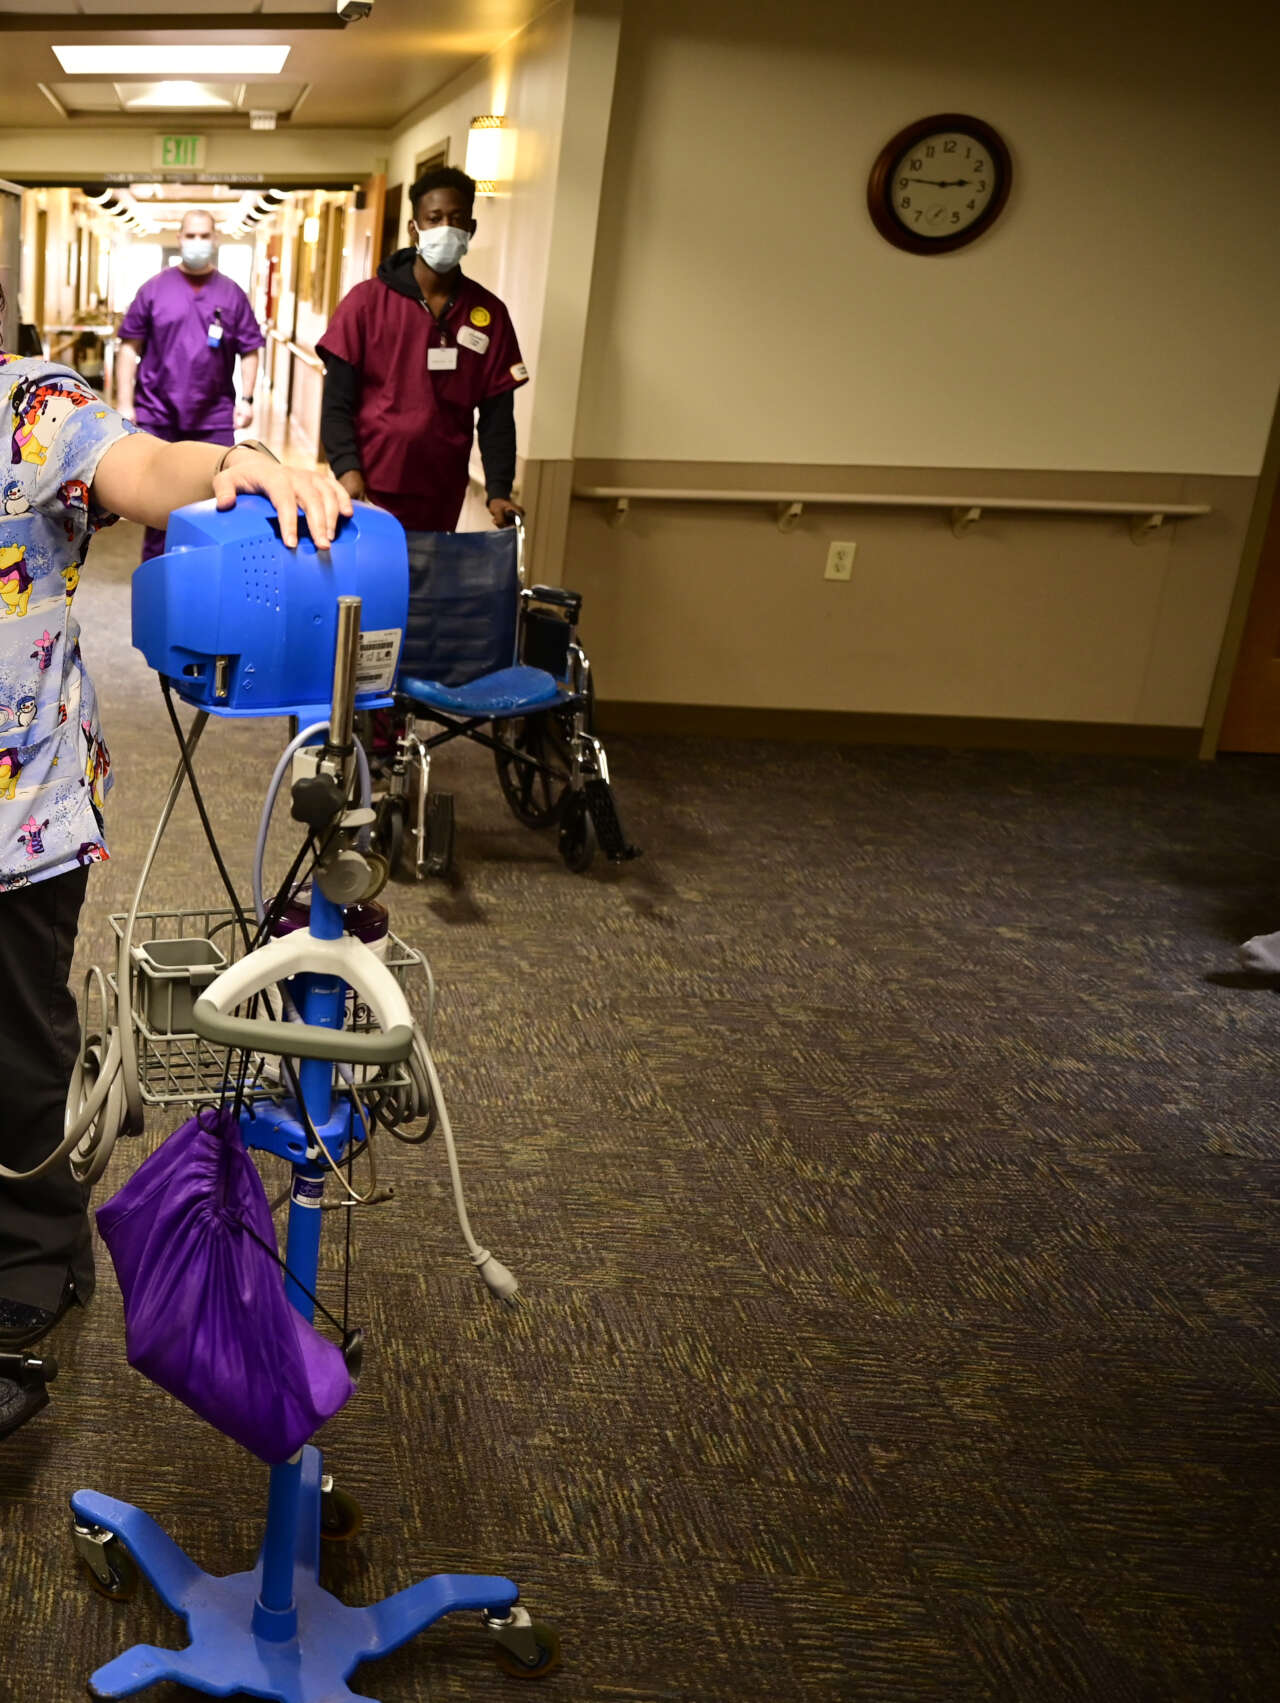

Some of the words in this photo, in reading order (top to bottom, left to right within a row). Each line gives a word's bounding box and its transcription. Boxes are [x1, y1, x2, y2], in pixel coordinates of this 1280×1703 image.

[162, 136, 200, 165] EXIT
[925, 146, 935, 158] 11
[943, 140, 957, 153] 12
[909, 159, 922, 172] 10
[974, 160, 983, 173] 2
[899, 178, 909, 190] 9
[976, 181, 986, 193] 3
[900, 197, 911, 209] 8
[966, 199, 975, 210] 4
[913, 211, 923, 222] 7
[950, 212, 960, 224] 5
